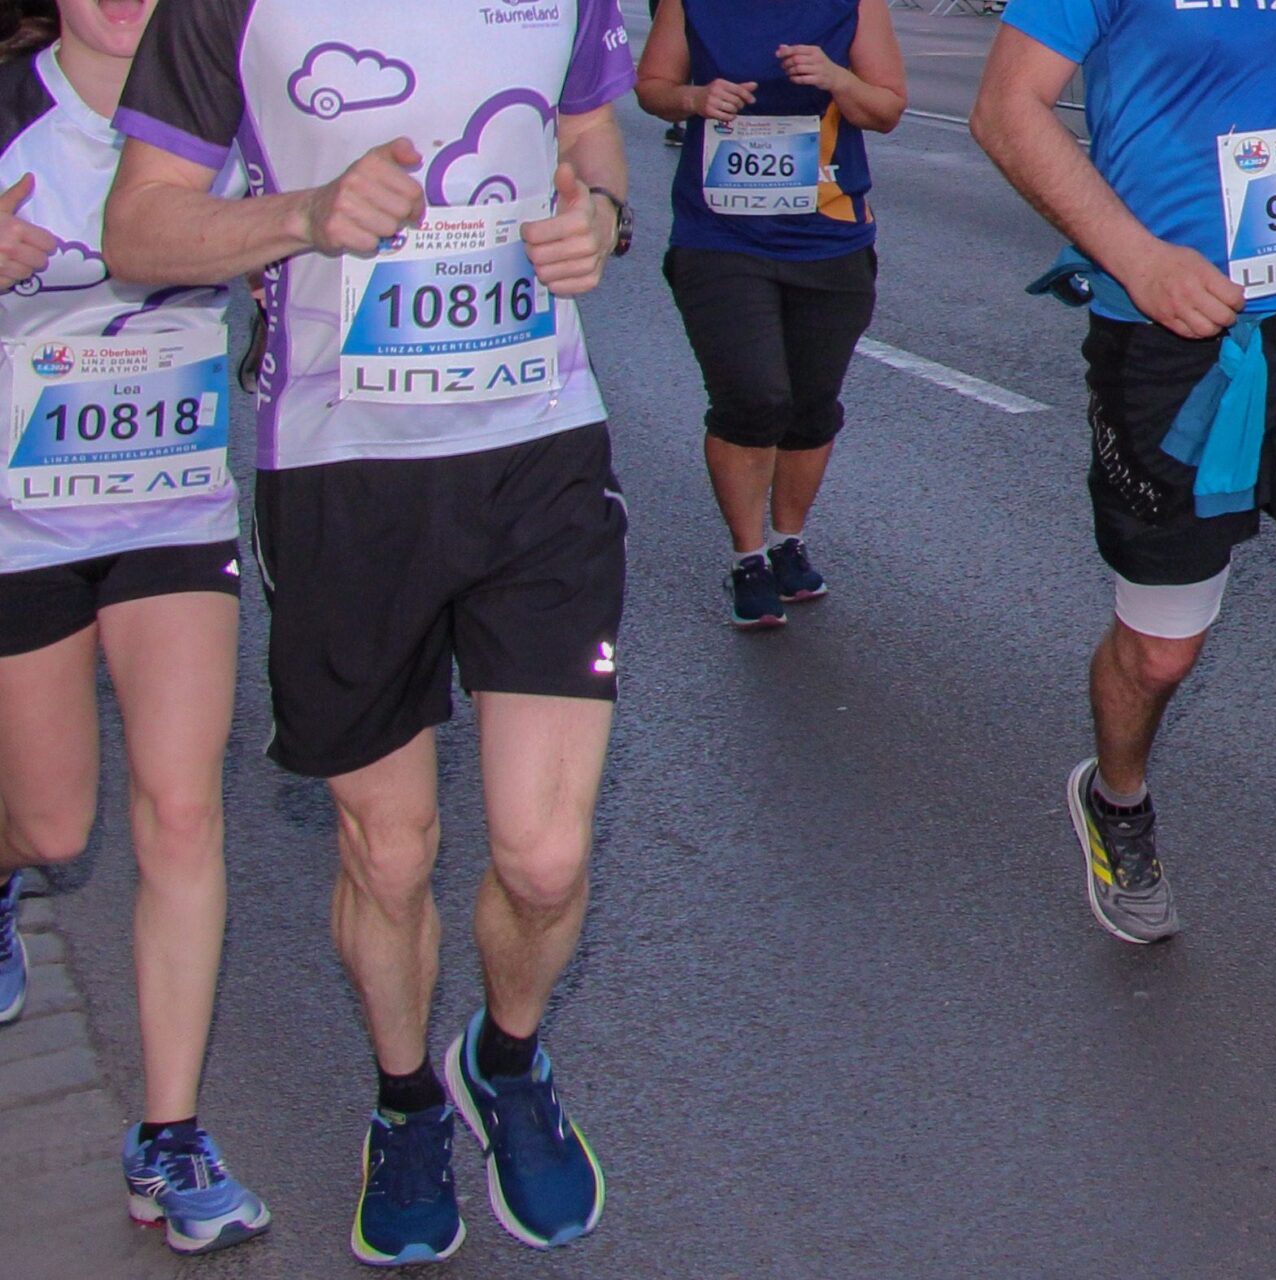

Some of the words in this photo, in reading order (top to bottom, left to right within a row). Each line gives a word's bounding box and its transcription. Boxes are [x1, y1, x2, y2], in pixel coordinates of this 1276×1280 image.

[479, 4, 560, 25] Träumeland
[727, 152, 795, 177] 9626
[710, 194, 768, 209] LINZ
[773, 196, 810, 209] AG
[434, 220, 485, 231] Oberbank
[416, 232, 440, 240] LINZ
[446, 230, 485, 240] DONAU
[416, 240, 485, 249] MARATHON
[435, 260, 493, 276] Roland
[379, 278, 533, 329] 10816
[429, 332, 532, 352] VIERTELMARATHON
[82, 349, 97, 357] 22.
[100, 348, 148, 358] Oberbank
[81, 358, 104, 366] LINZ
[109, 357, 148, 365] DONAU
[81, 365, 148, 374] MARATHON
[356, 367, 475, 393] LINZ
[486, 358, 546, 389] AG
[113, 384, 141, 395] Lea
[46, 398, 200, 441] 10818
[92, 443, 198, 461] VIERTELMARATHON
[24, 473, 135, 499] LINZ
[145, 466, 212, 492] AG
